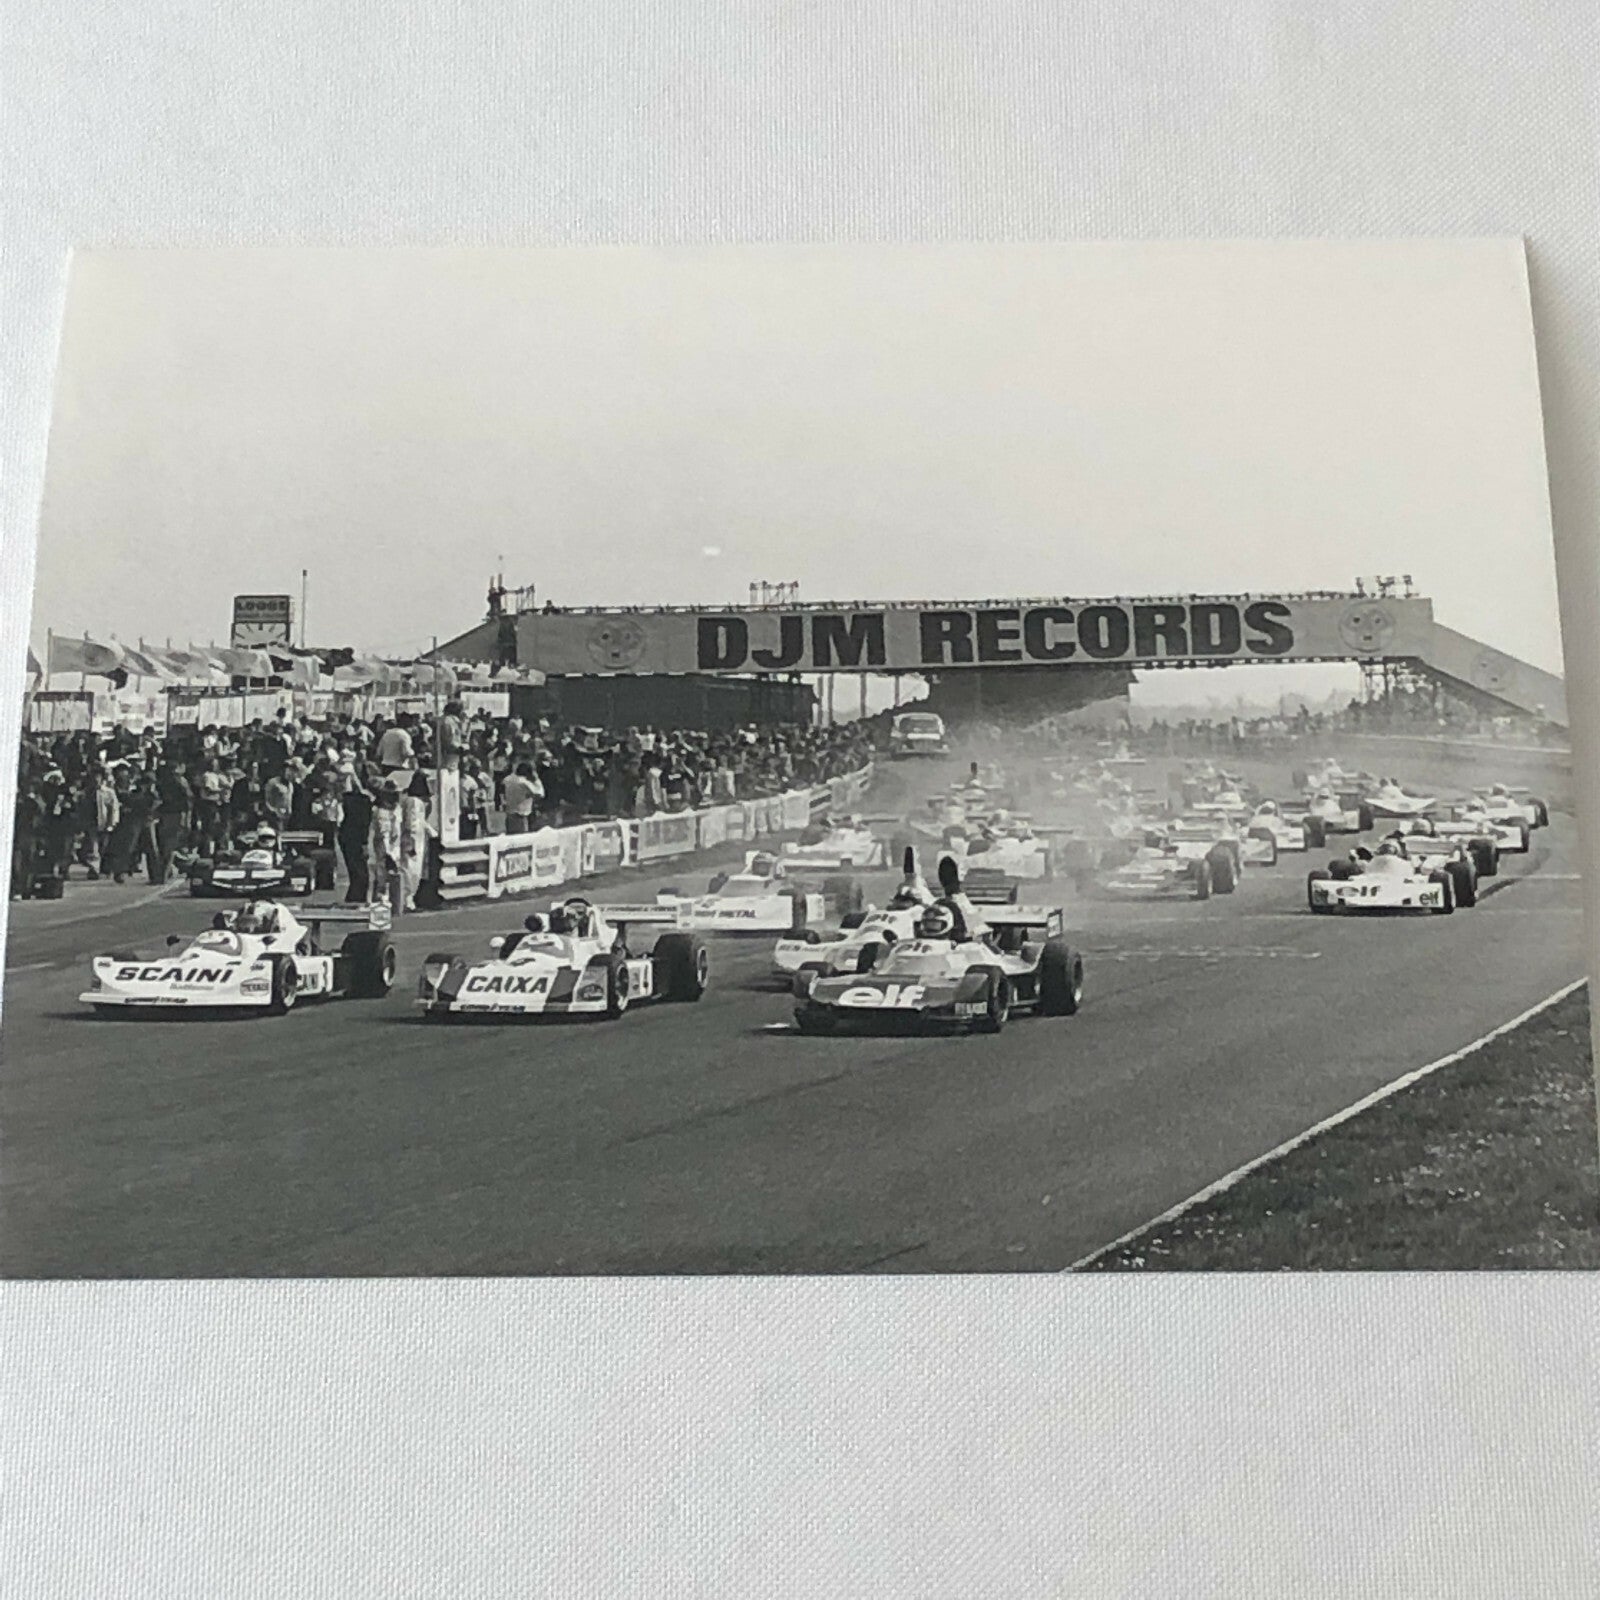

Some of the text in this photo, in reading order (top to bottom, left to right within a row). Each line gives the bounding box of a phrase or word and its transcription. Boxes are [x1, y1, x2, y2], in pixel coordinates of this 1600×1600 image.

[698, 601, 1295, 670] DJM RECORDS
[1419, 891, 1440, 905] elf
[115, 966, 233, 983] SCAINI
[466, 975, 548, 994] CAIXA
[838, 984, 926, 1007] elf
